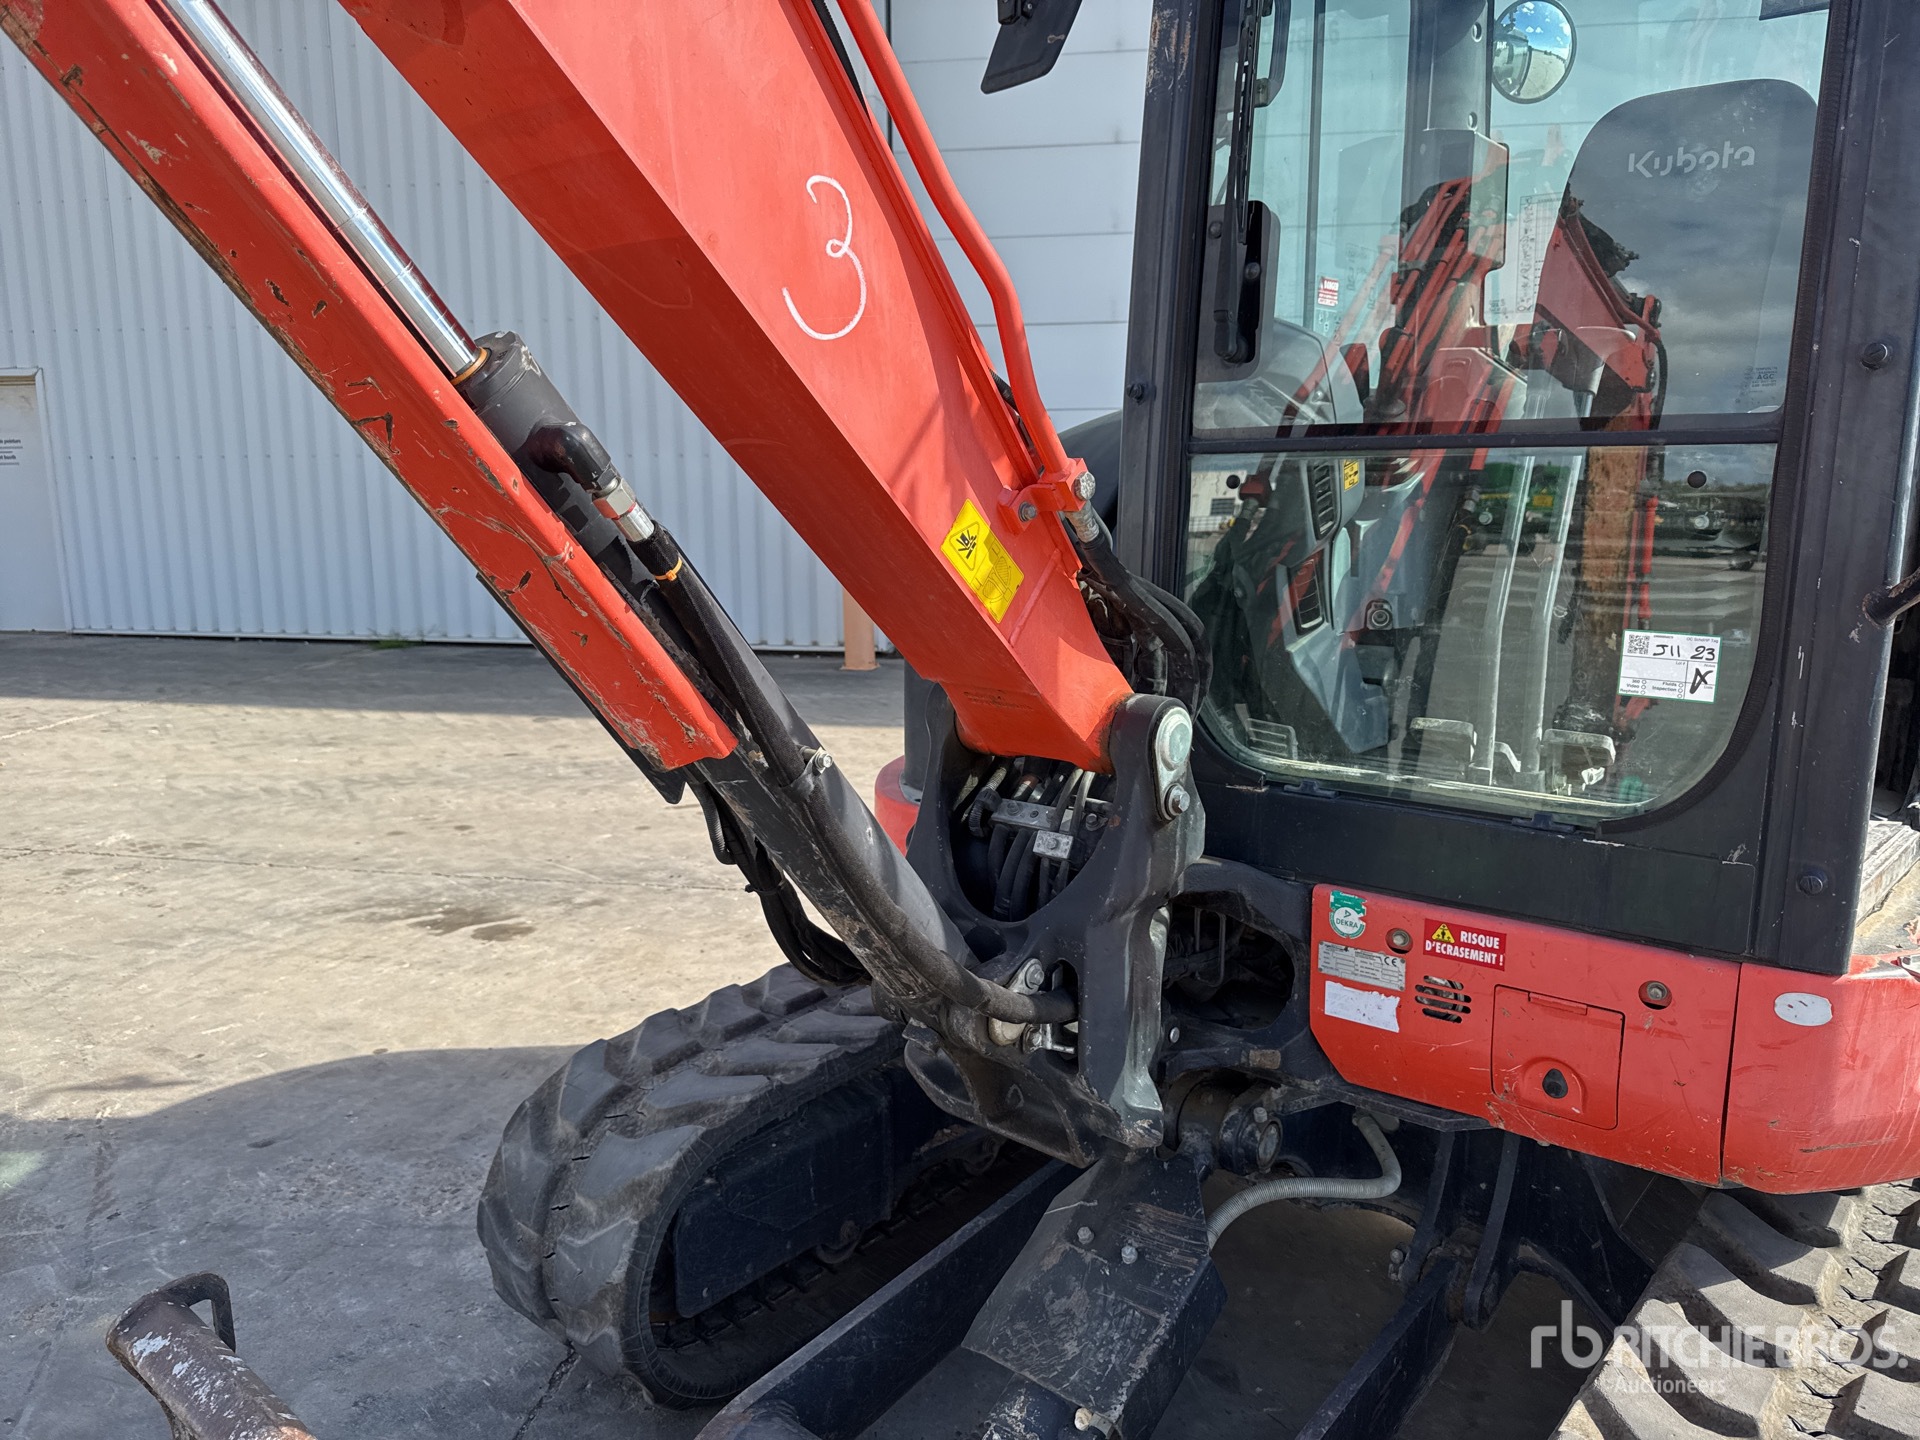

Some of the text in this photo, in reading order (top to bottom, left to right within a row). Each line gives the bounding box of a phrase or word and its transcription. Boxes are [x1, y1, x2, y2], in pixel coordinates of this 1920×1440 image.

[1627, 140, 1756, 178] Kubota
[782, 174, 867, 341] 3
[1689, 645, 1716, 661] 23
[1335, 917, 1359, 929] DEKRA
[1460, 930, 1500, 949] RISQUE
[1425, 940, 1497, 965] D'ECRASEMENT
